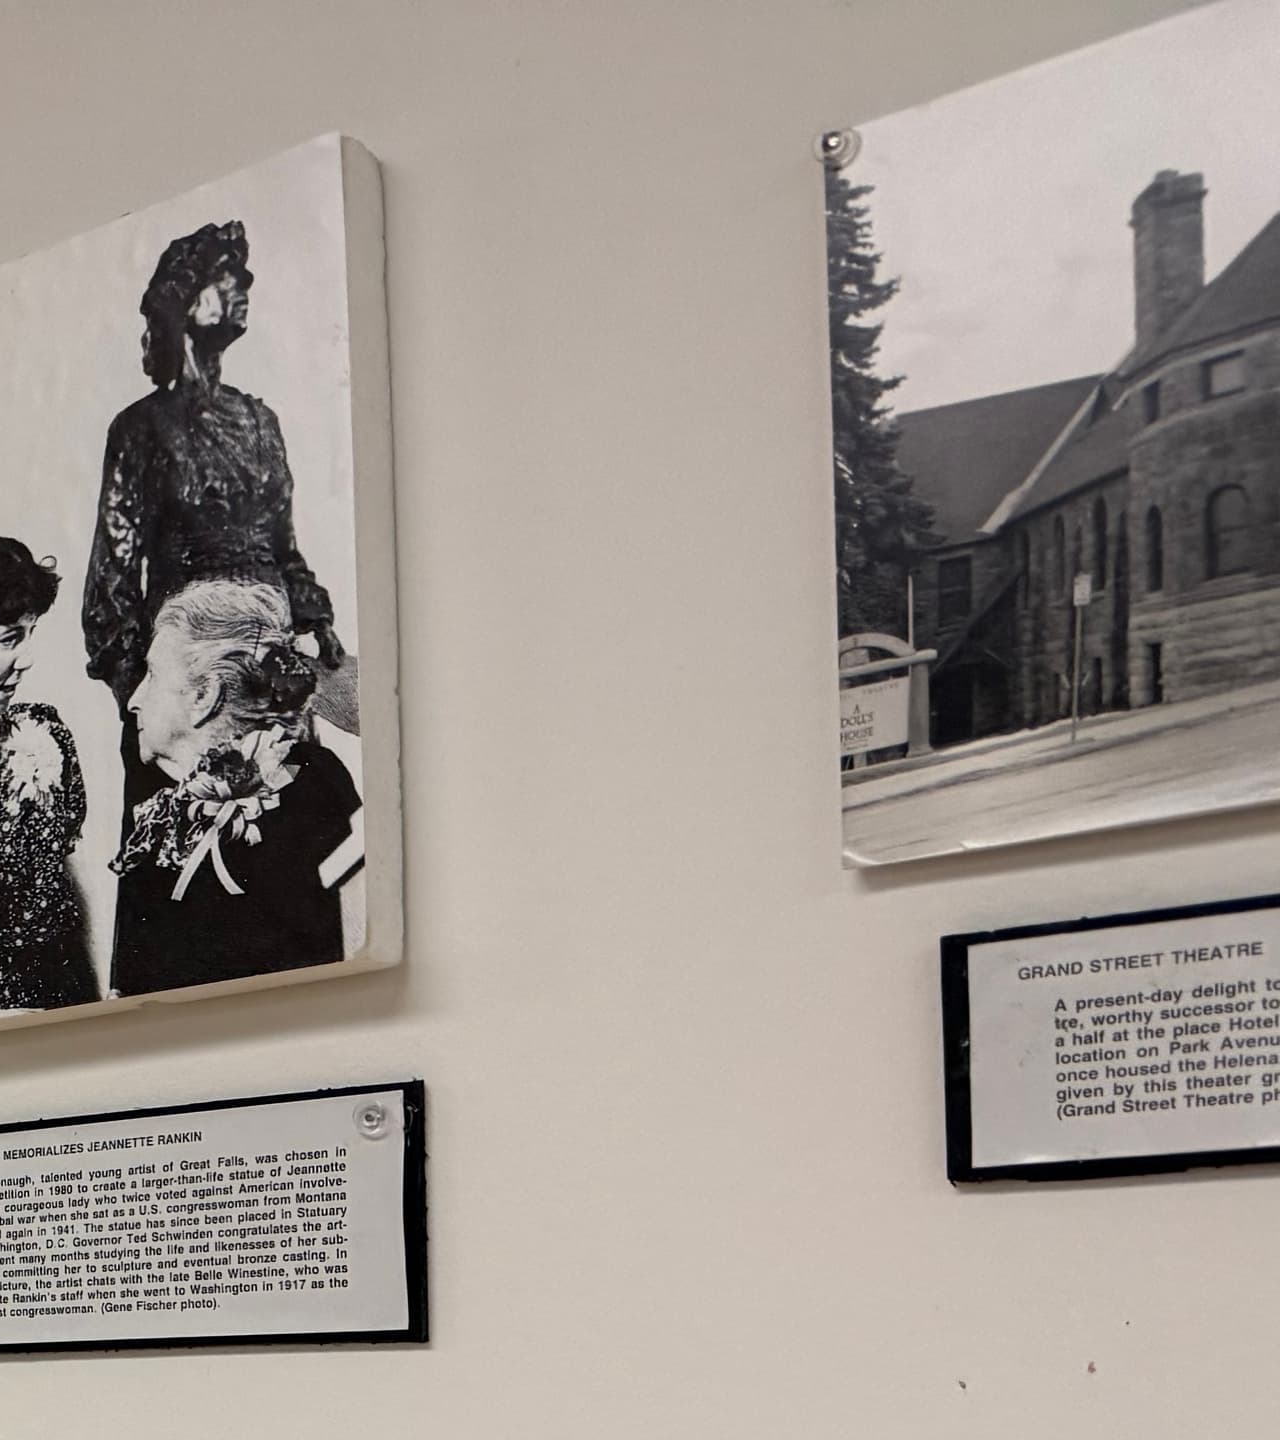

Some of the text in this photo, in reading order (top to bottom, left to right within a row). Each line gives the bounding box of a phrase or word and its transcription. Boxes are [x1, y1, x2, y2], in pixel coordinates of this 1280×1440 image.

[1017, 940, 1263, 981] GRAND STREET THEATRE
[1053, 976, 1280, 1013] A present-day delight to
[1091, 1007, 1152, 1029] worthy
[1160, 1000, 1253, 1019] successor
[1262, 994, 1280, 1009] to
[1054, 1013, 1280, 1047] a half at the place Hotel
[1054, 1046, 1126, 1064] location
[1135, 1046, 1159, 1057] on
[1168, 1038, 1210, 1054] Park
[1056, 1049, 1280, 1082] once housed the Helena
[1055, 1070, 1252, 1103] given by this theater
[1056, 1088, 1254, 1120] (Grand Street Theatre
[2, 1142, 84, 1160] MEMORIALIZES
[86, 1135, 154, 1152] JEANNETTE
[157, 1130, 202, 1145] RANKIN
[40, 1171, 82, 1184] talented
[88, 1169, 121, 1182] young
[127, 1164, 155, 1176] artist
[161, 1162, 173, 1173] of
[179, 1158, 210, 1171] Great
[217, 1155, 248, 1169] Falls,
[254, 1155, 278, 1164] was
[284, 1147, 328, 1162] chosen
[334, 1146, 346, 1157] in
